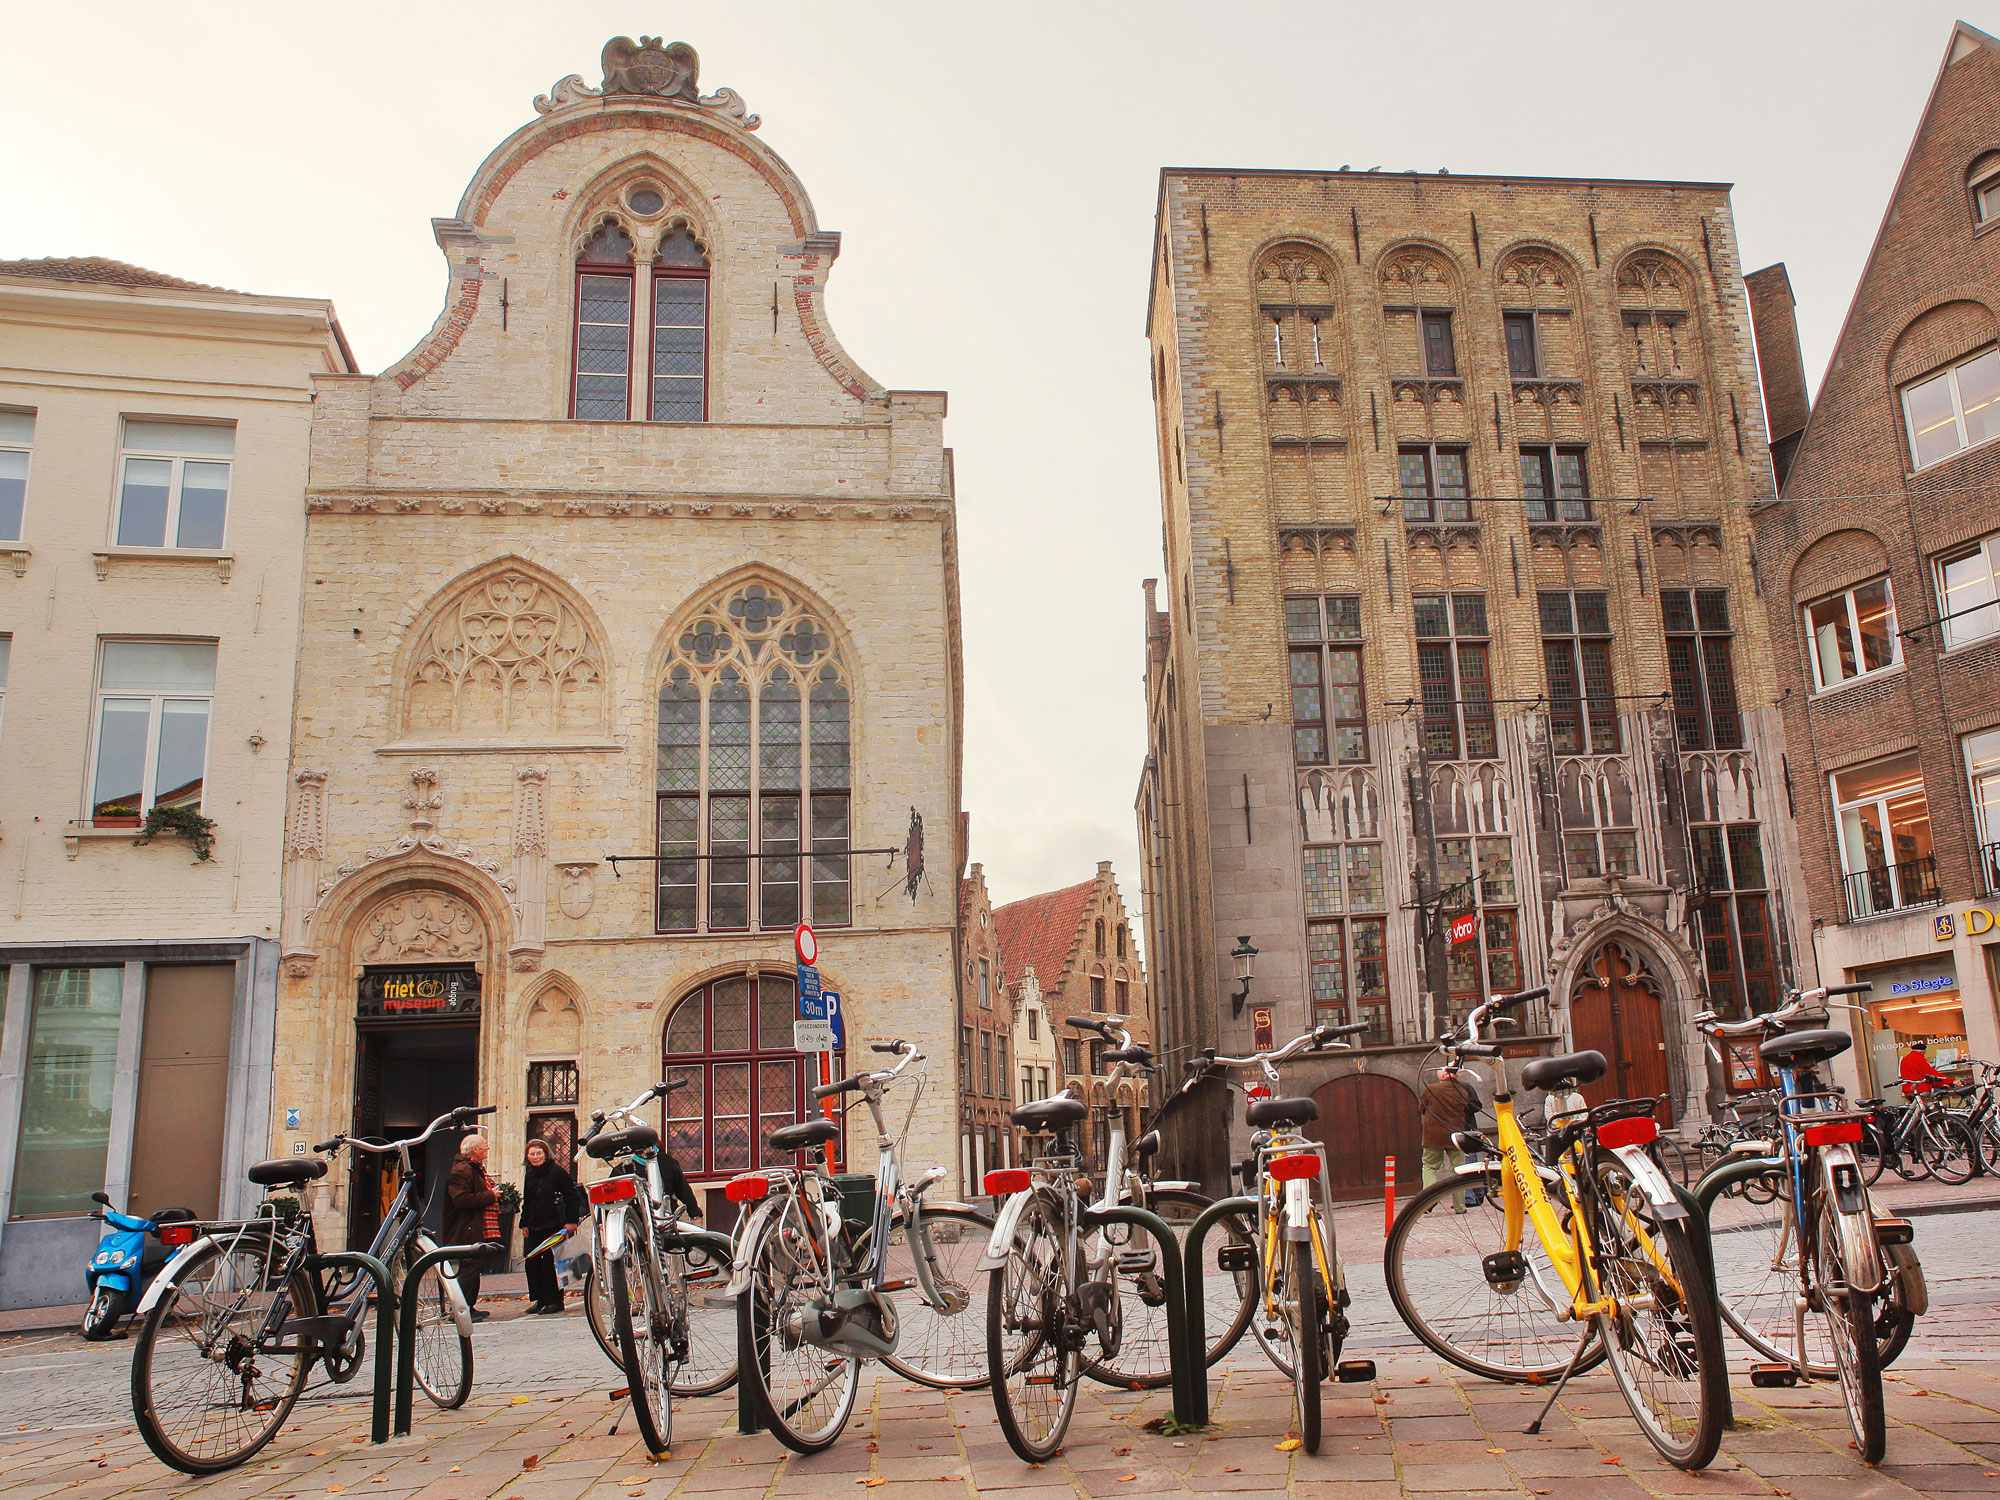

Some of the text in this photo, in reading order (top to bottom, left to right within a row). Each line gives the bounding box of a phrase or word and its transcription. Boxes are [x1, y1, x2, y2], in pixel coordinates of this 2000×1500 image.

[1453, 922, 1472, 939] vbro
[1961, 908, 2000, 936] D
[384, 980, 415, 998] friet
[448, 981, 459, 1007] Brugge
[1890, 977, 1953, 994] De Slegte
[383, 998, 446, 1010] museum
[826, 995, 837, 1019] P
[1873, 1042, 1905, 1051] inkoop
[1926, 1034, 1963, 1045] boeken
[295, 1143, 304, 1152] 33
